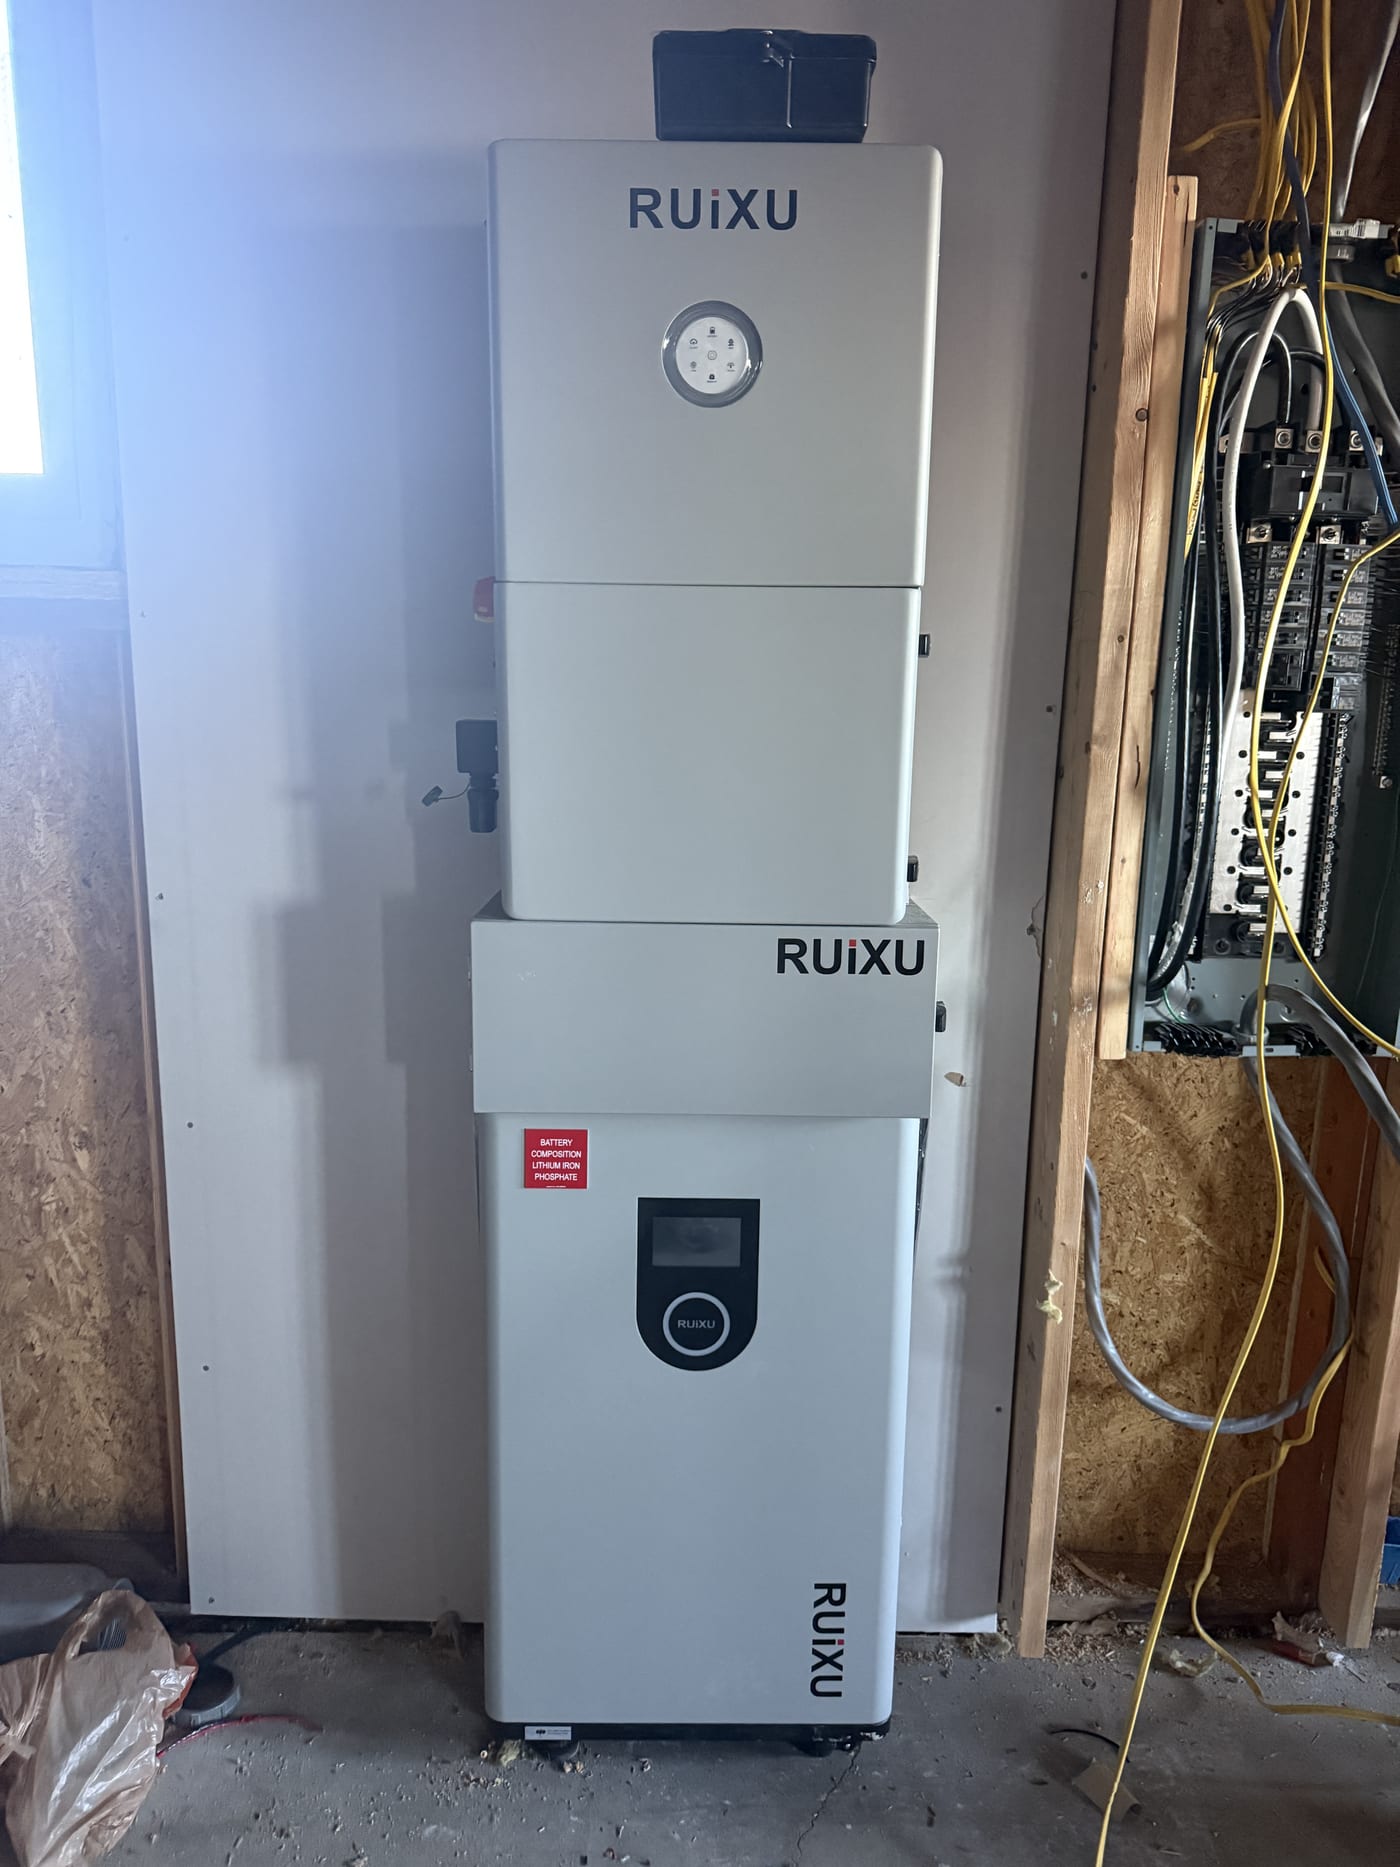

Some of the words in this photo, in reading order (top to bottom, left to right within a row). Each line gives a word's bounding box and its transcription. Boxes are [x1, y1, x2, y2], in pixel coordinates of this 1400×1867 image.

[629, 187, 798, 231] RUiXU
[777, 938, 925, 975] RUiXU
[540, 1138, 573, 1147] BATTERY
[531, 1150, 582, 1158] COMPOSITION
[532, 1161, 561, 1169] LITHIUM
[562, 1161, 581, 1169] IRON
[534, 1173, 578, 1181] PHOSPHATE
[810, 1583, 846, 1697] RUiXU
